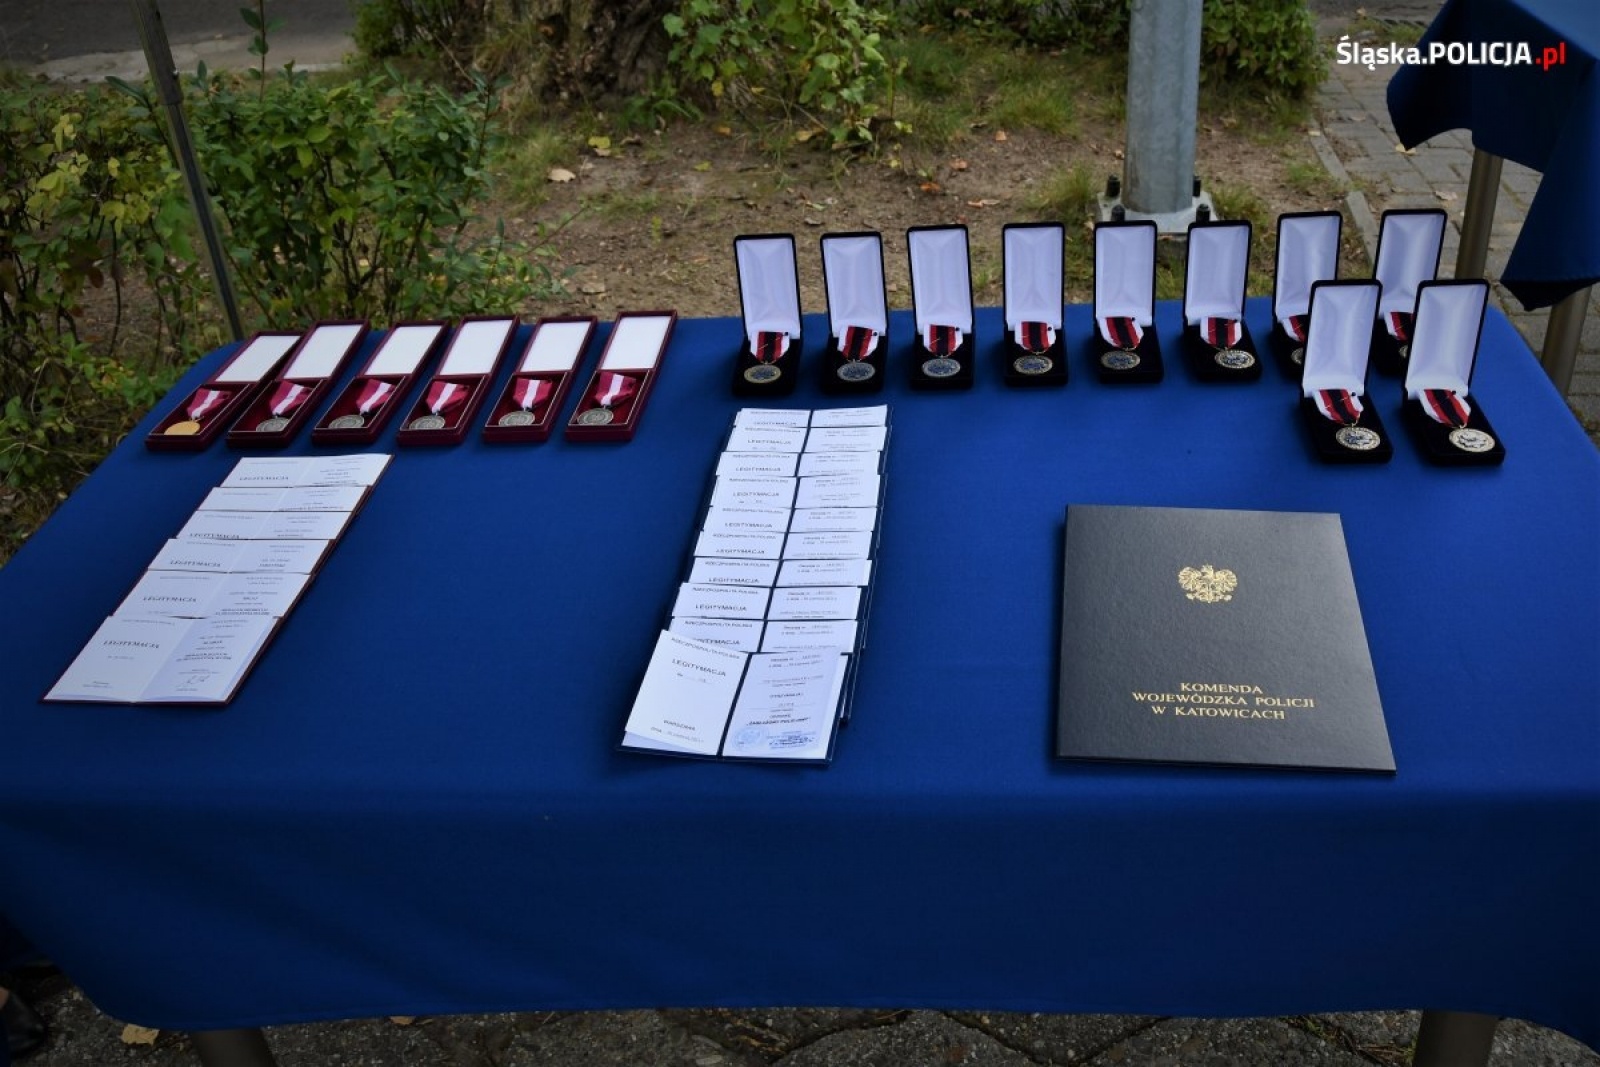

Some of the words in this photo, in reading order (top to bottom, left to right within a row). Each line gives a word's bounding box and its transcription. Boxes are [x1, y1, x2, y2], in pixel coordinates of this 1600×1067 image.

[708, 576, 760, 584] LEGITYMACJA
[695, 603, 748, 611] LEGITYMACJA
[672, 658, 726, 677] LEGITYMACJA
[1180, 682, 1264, 695] KOMENDA
[1131, 691, 1248, 706] WOJEWÓDZKA
[1256, 696, 1316, 708] POLICJI
[1151, 706, 1166, 715] W
[1175, 706, 1286, 720] KATOWICACH
